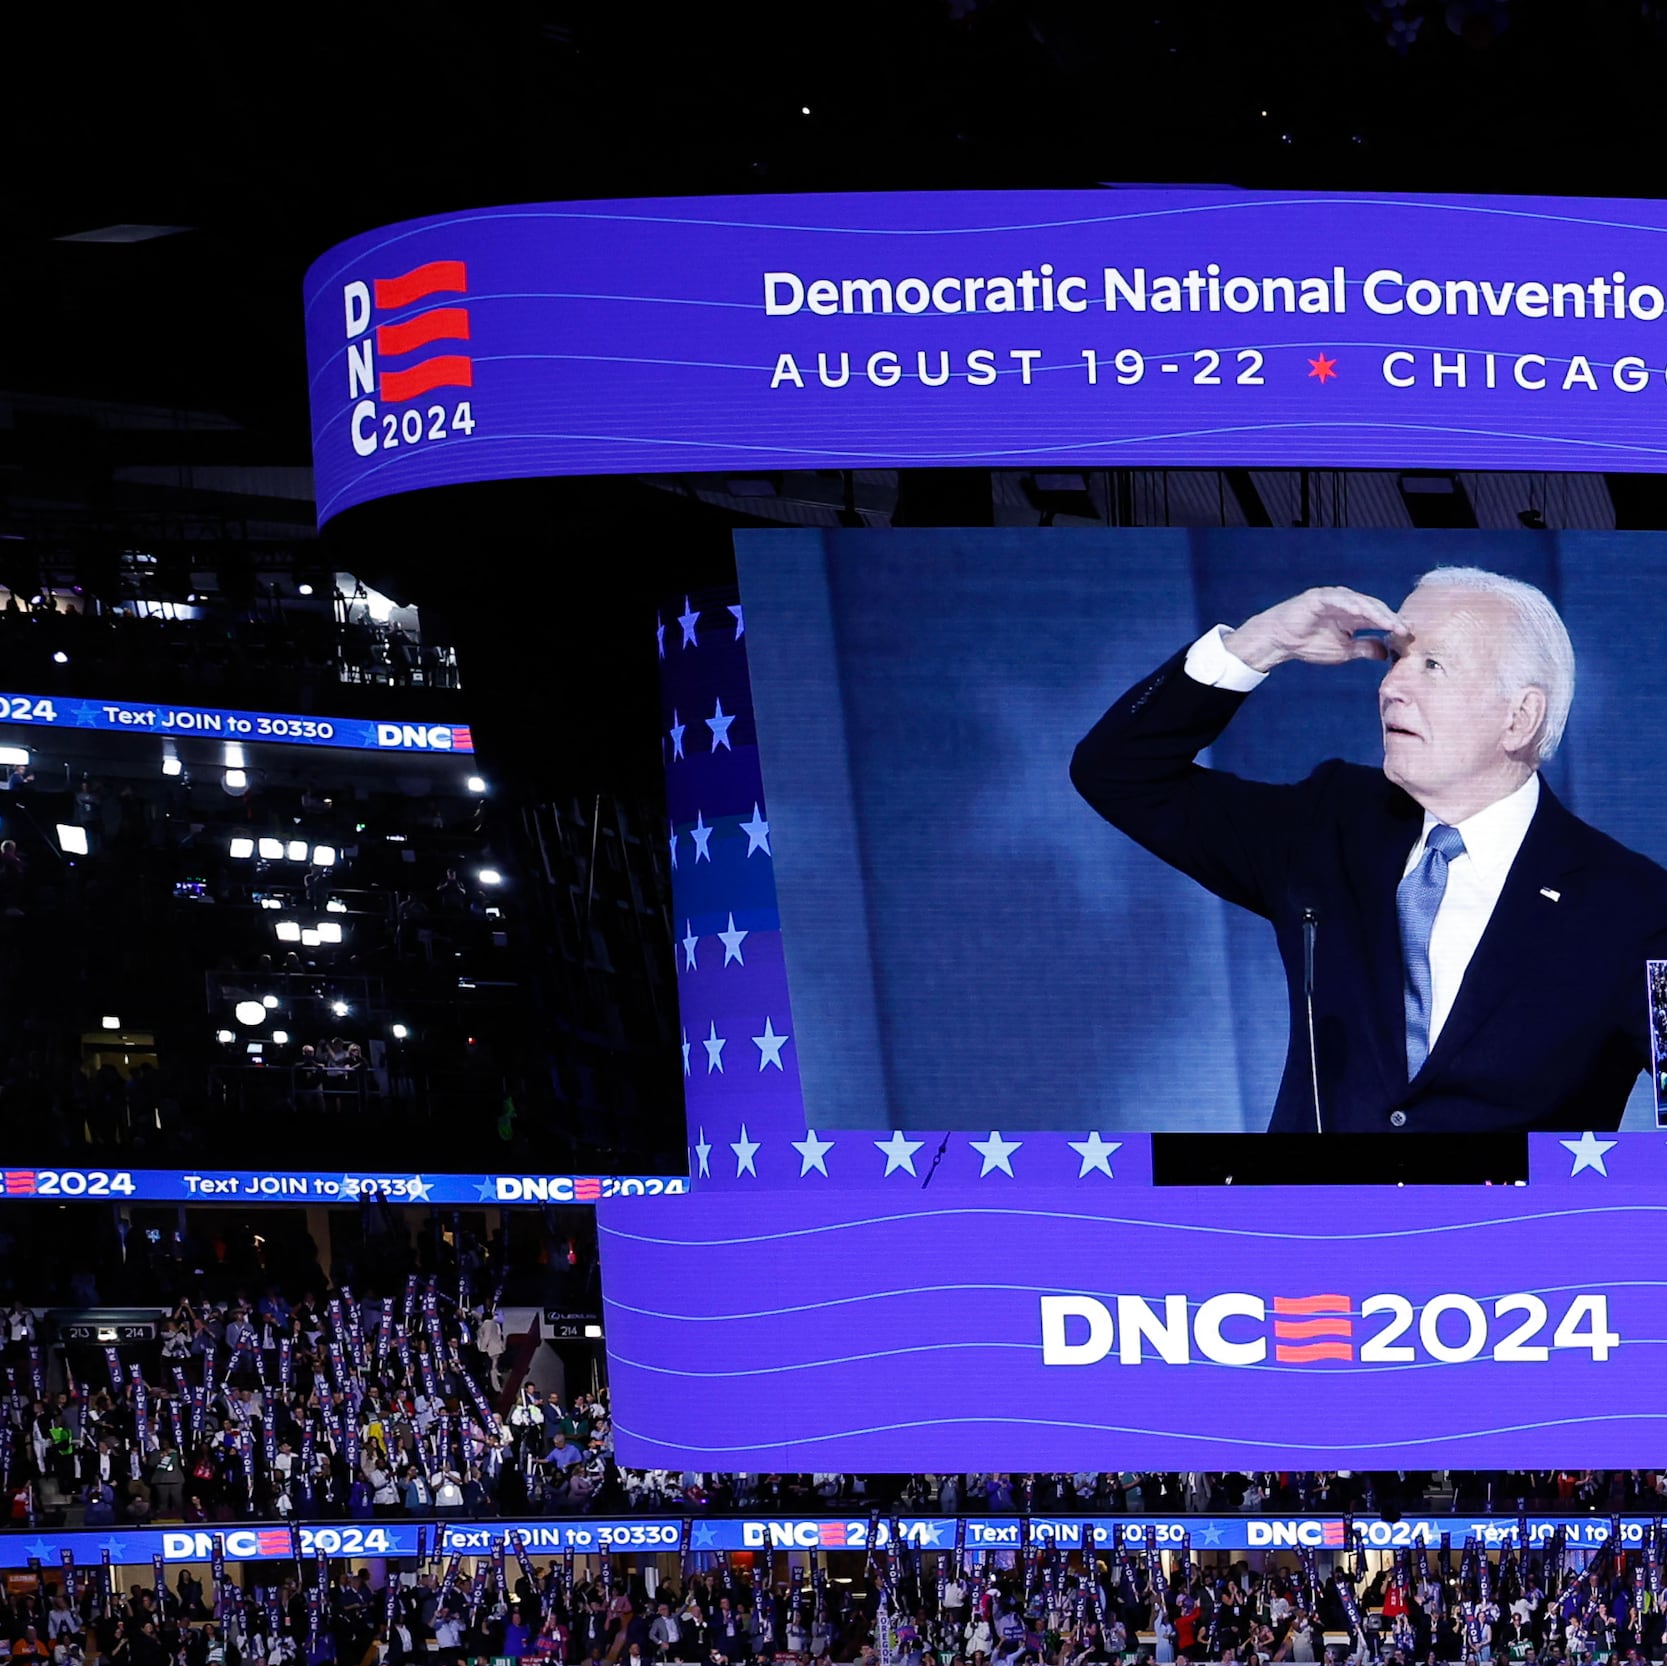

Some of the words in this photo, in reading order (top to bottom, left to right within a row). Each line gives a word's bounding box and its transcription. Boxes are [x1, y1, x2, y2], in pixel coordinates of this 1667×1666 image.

[764, 266, 1086, 316] Democratic
[1102, 264, 1350, 314] National
[770, 350, 1041, 389] AUGUST
[1081, 347, 1267, 386] 19-22
[380, 399, 476, 449] 2024
[103, 706, 156, 726] Text
[161, 710, 221, 731] JOIN
[224, 716, 252, 734] to
[257, 718, 333, 739] 30330
[377, 724, 450, 749] DNC
[37, 1172, 135, 1195] 2024
[184, 1176, 239, 1193] Text
[244, 1175, 307, 1194] JOIN
[314, 1177, 338, 1195] to
[345, 1177, 423, 1196] 30330
[496, 1177, 572, 1201] DNC
[125, 1327, 144, 1338] 214
[561, 1327, 577, 1337] 214
[1040, 1294, 1267, 1366] DNC
[1361, 1293, 1619, 1366] 2024
[300, 1528, 389, 1553] 2024
[565, 1528, 588, 1547] to
[597, 1525, 678, 1544] 30330
[969, 1523, 1017, 1542] Text
[1247, 1521, 1321, 1546] DNC
[1471, 1522, 1519, 1542] Text
[1584, 1523, 1608, 1542] to
